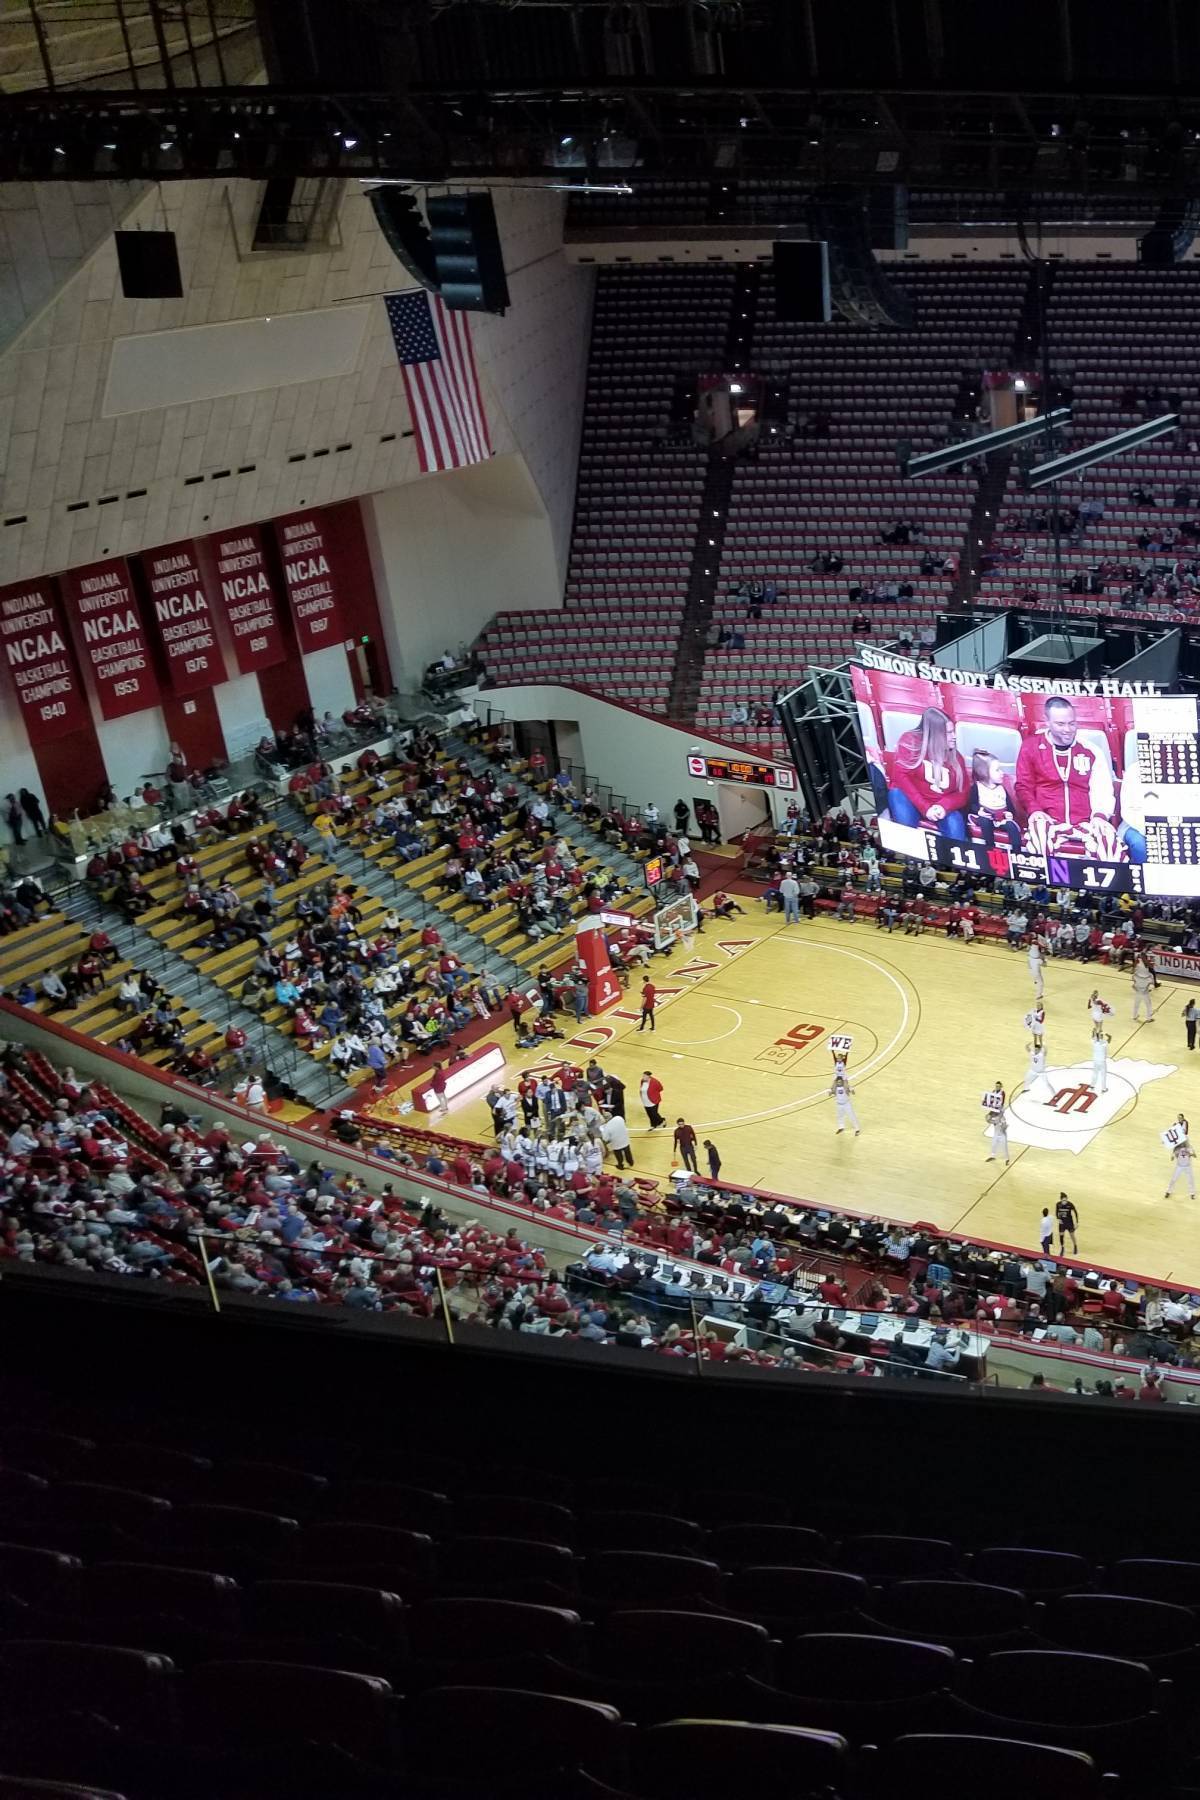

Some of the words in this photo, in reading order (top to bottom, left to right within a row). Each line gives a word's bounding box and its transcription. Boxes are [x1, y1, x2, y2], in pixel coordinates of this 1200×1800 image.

[284, 521, 316, 540] INDIANA
[220, 537, 256, 556] INDIANA
[282, 536, 323, 557] UNIVERSITY
[153, 554, 191, 574] INDIANA
[218, 552, 262, 574] UNIVERSITY
[286, 555, 330, 584] NCAA
[80, 572, 120, 594] INDIANA
[152, 569, 199, 592] UNIVERSITY
[222, 572, 270, 601] NCAA
[292, 581, 334, 602] BASKETBALL
[2, 592, 45, 616] INDIANA
[79, 588, 128, 612] UNIVERSITY
[155, 590, 208, 621] NCAA
[228, 598, 272, 621] BASKETBALL
[297, 596, 334, 618] CHAMPIONS
[0, 608, 54, 635] UNIVERSITY
[83, 610, 140, 642] NCAA
[162, 617, 212, 642] BASKETBALL
[234, 614, 274, 636] CHAMPIONS
[6, 631, 66, 665] NCAA
[90, 638, 144, 663] BASKETBALL
[168, 634, 214, 657] CHAMPIONS
[15, 660, 70, 686] BASKETBALL
[97, 655, 146, 679] CHAMPIONS
[860, 650, 916, 678] SIMON
[918, 662, 989, 688] SKJODT
[993, 673, 1098, 698] ASSEMBLY
[1102, 678, 1161, 698] HALL
[22, 677, 72, 703] CHAMPIONS
[40, 702, 66, 720] 1940
[950, 847, 980, 870] 11
[1052, 859, 1070, 884] N
[1083, 867, 1115, 887] 17
[480, 938, 761, 1100] NDIANA
[831, 1036, 852, 1050] WE
